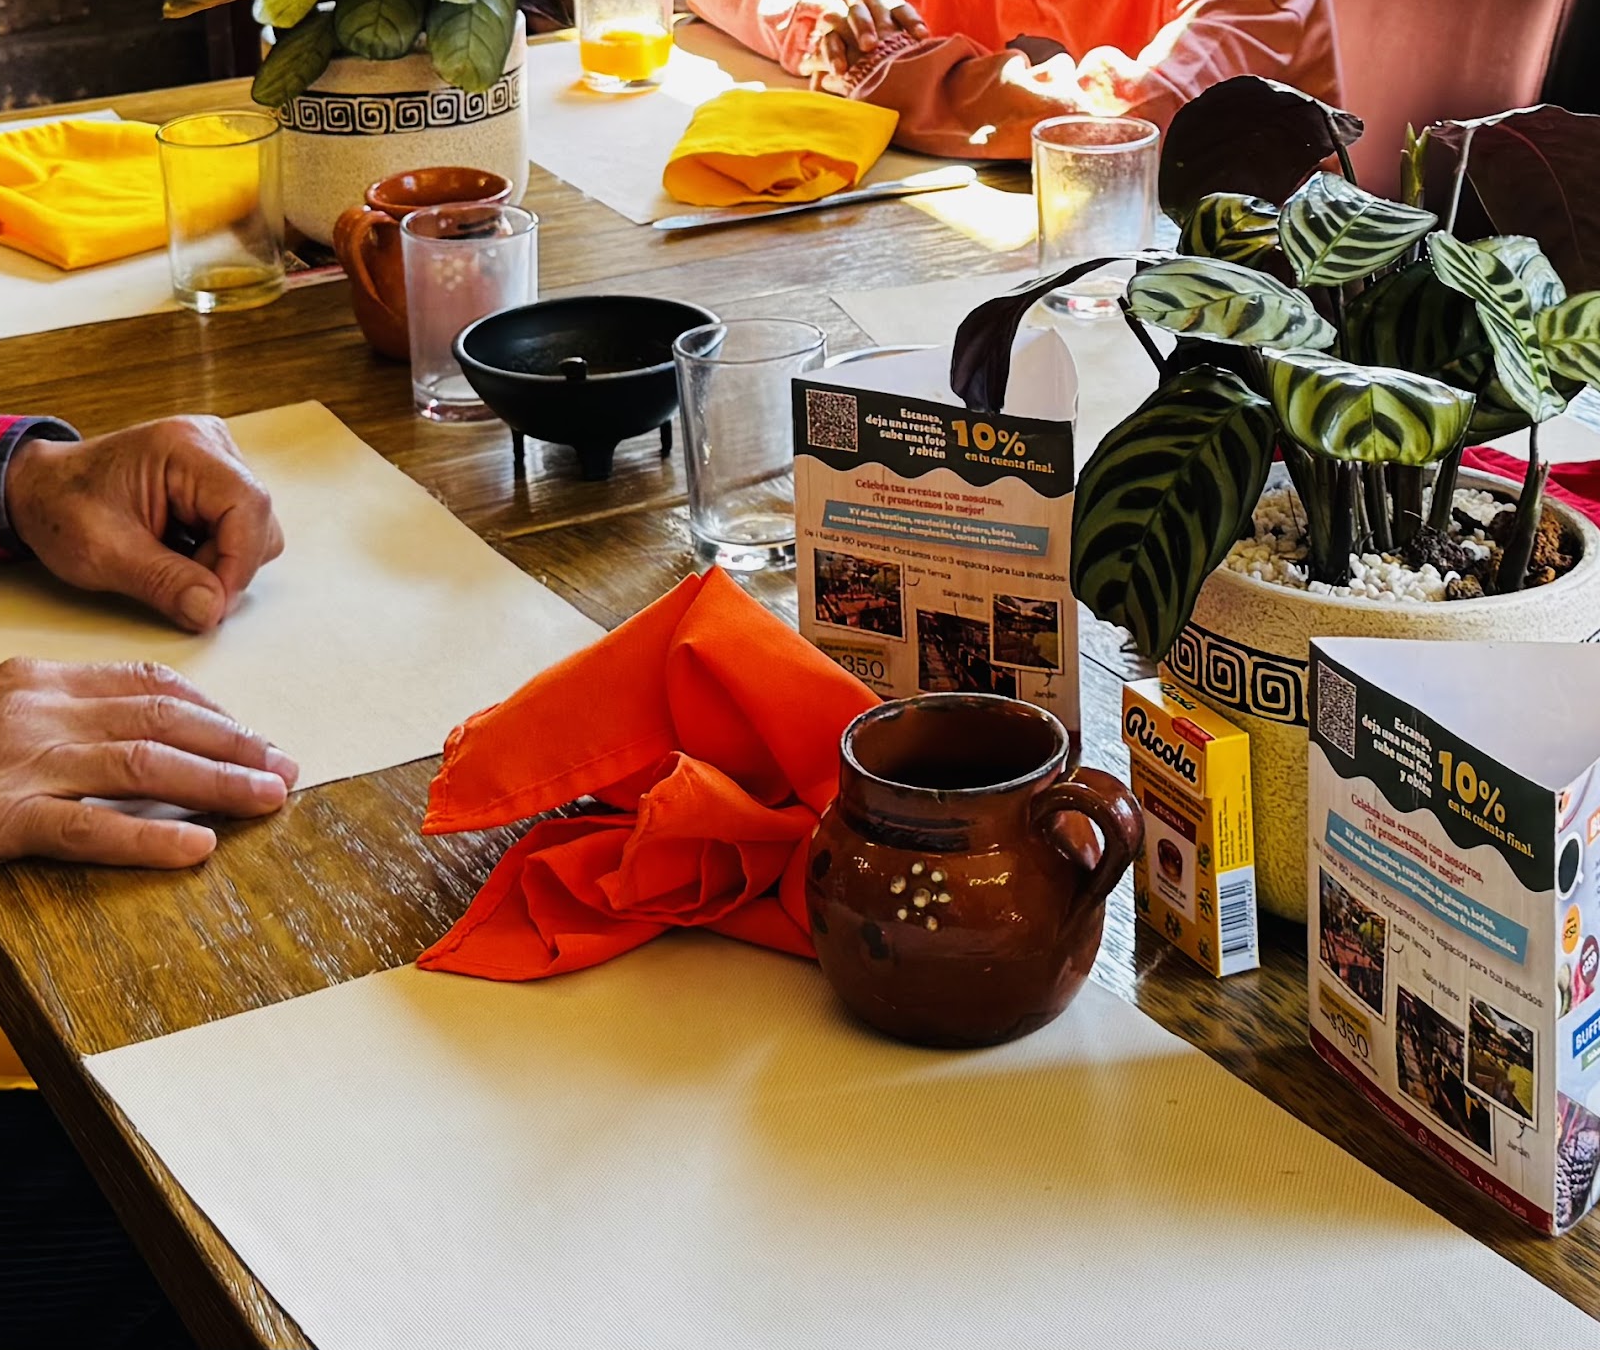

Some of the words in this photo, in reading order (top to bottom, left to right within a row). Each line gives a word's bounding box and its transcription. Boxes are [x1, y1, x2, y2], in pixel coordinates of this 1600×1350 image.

[865, 414, 887, 426] deja
[888, 419, 907, 429] una
[908, 423, 945, 436] reseña,
[900, 408, 942, 423] Escanea,
[879, 429, 903, 440] sube
[904, 433, 922, 443] una
[925, 435, 945, 446] foto
[908, 446, 914, 455] y
[914, 446, 945, 458] obtén
[951, 420, 1025, 455] 10%
[965, 452, 977, 461] en
[978, 453, 990, 463] tu
[991, 457, 1025, 468] cuenta
[1026, 460, 1054, 473] final.
[887, 496, 942, 509] prometemos
[944, 501, 952, 511] lo
[954, 505, 984, 515] mejor!
[907, 487, 941, 497] eventos
[943, 492, 959, 500] con
[893, 546, 931, 559] Contamos
[956, 559, 989, 570] espacios
[991, 565, 1009, 574] para
[1011, 568, 1024, 577] tus
[1126, 706, 1197, 783] Ricola
[1362, 714, 1380, 734] deja
[1381, 729, 1399, 745] una
[1401, 739, 1433, 767] reseña,
[1394, 717, 1432, 750] Escanea,
[1373, 739, 1394, 758] sube
[1395, 752, 1413, 769] una
[1414, 761, 1432, 781] foto
[1400, 769, 1406, 782] y
[1407, 774, 1432, 797] obtén
[1438, 751, 1506, 821] 10%
[1448, 798, 1460, 813] en
[1461, 805, 1472, 820] tu
[1473, 814, 1505, 840] cuenta
[1507, 832, 1534, 857] final.
[1378, 827, 1427, 862] prometemos
[1429, 856, 1437, 869] lo
[1438, 864, 1464, 887] mejor!
[1381, 813, 1395, 827] tus
[1397, 823, 1427, 847] eventos
[1428, 842, 1443, 857] con
[1444, 853, 1484, 883] nosotros,
[1381, 894, 1416, 923] Contamos
[1436, 936, 1467, 961] espacios
[1469, 957, 1488, 974] para
[1330, 1008, 1368, 1057] $350
